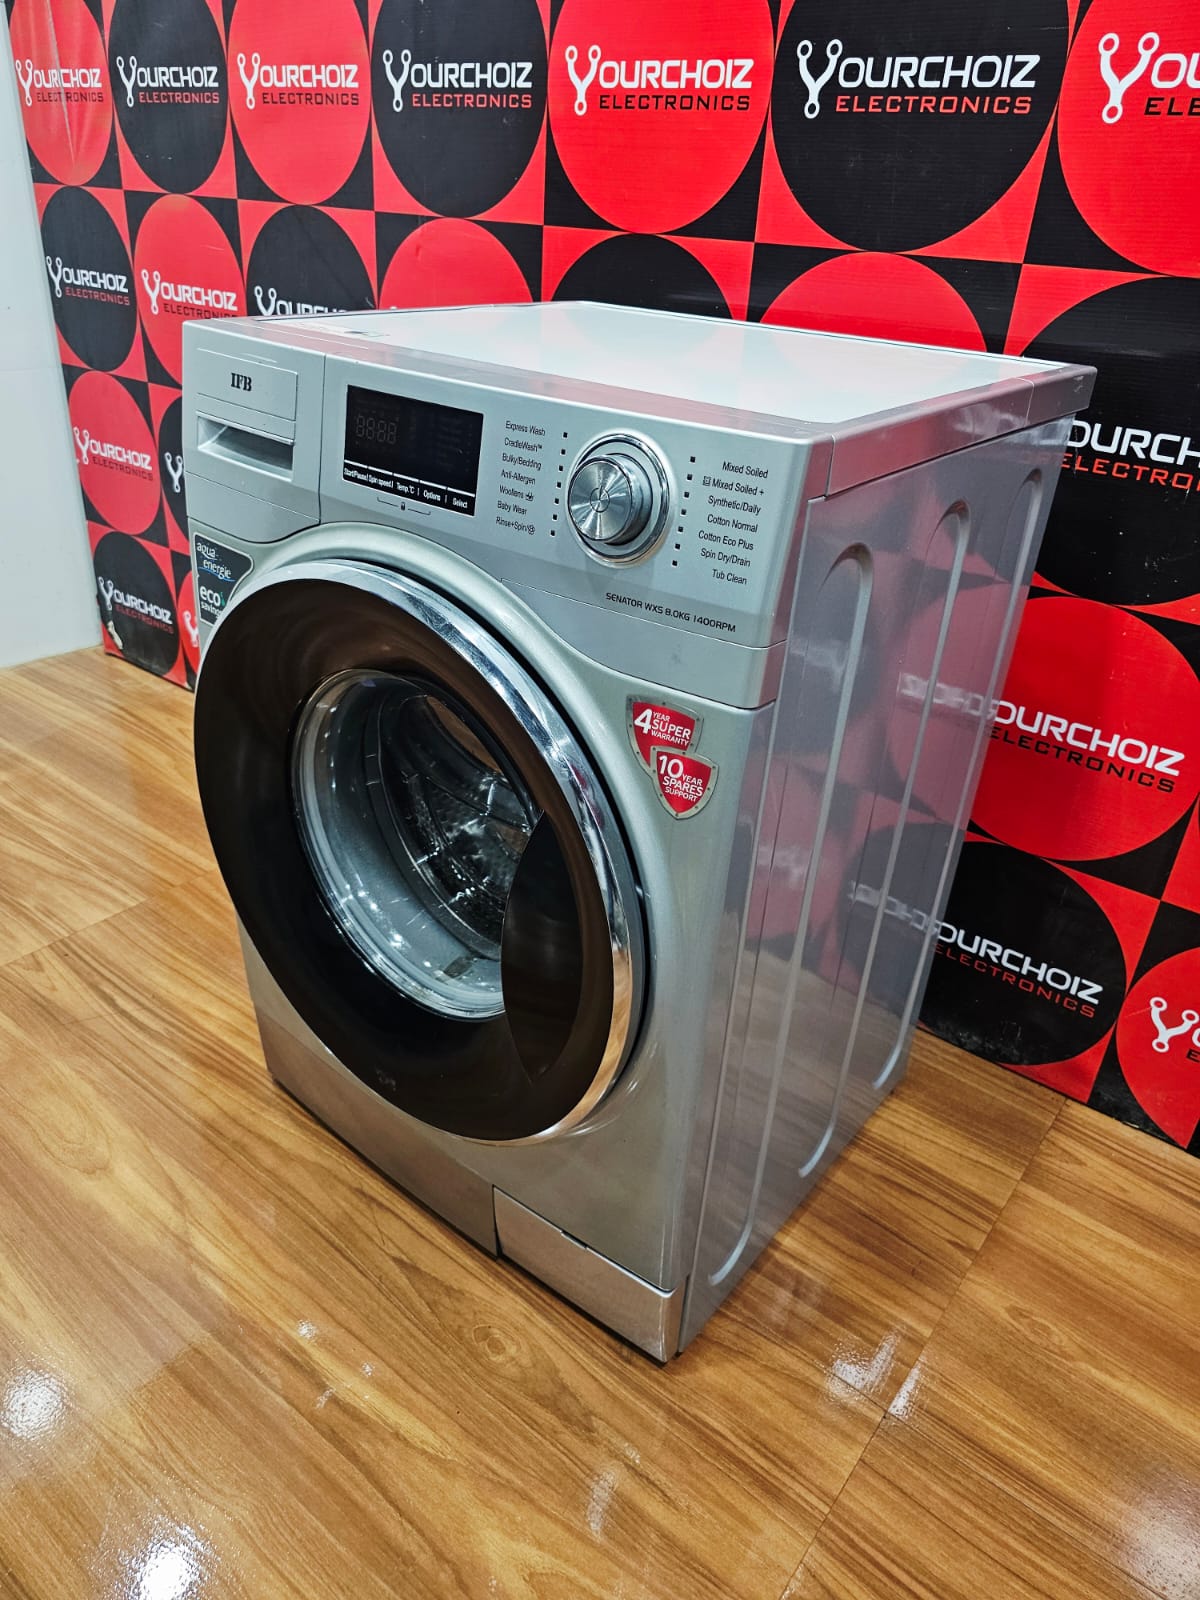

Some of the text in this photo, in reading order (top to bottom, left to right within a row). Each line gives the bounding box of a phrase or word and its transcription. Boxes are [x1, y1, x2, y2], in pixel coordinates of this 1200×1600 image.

[15, 59, 102, 107] YOURCHOIZ
[116, 55, 219, 108] YOURCHOIZ
[236, 52, 360, 110] YOURCHOIZ
[382, 49, 533, 112] YOURCHOIZ
[564, 44, 754, 115] YOURCHOIZ
[797, 38, 1041, 119] YOURCHOIZ
[36, 91, 104, 103] ELECTRONICS
[138, 91, 220, 105] ELECTRONICS
[260, 92, 360, 106] ELECTRONICS
[411, 94, 533, 109] ELECTRONICS
[599, 94, 751, 112] ELECTRONICS
[835, 95, 1032, 115] ELECTRONICS
[45, 255, 129, 298] YOURCHOIZ
[64, 286, 130, 306] ELECTRONICS
[141, 268, 238, 315] YOURCHOIZ
[230, 372, 253, 392] IFB
[505, 420, 546, 436] Express Wash
[73, 426, 153, 471] YOURCHOIZ
[502, 452, 541, 471] Bulky/Bedding
[722, 460, 769, 479] Mixed Soiled
[501, 468, 536, 485] Anti-Allergen
[1060, 452, 1200, 492] ELECTRO
[499, 484, 524, 499] Woollens
[712, 478, 734, 491] Mixed
[734, 482, 758, 496] Soiled
[423, 490, 441, 501] Options
[452, 497, 468, 509] Select
[497, 500, 528, 516] Baby Wear
[708, 495, 761, 516] Synthetic/Daily
[707, 513, 758, 533] Cotton Normal
[698, 529, 754, 551] Cotton Eco Plus
[196, 542, 217, 560] aqua
[700, 547, 751, 567] Spin Dry/Drain
[203, 559, 232, 580] energie
[712, 568, 747, 585] Tub Clean
[98, 576, 173, 625] YOURCHOIZ
[199, 586, 221, 607] eco
[605, 592, 736, 632] SENATOR WXS 8.0KG 1400RPM
[634, 708, 653, 735] 4
[653, 711, 671, 722] YEAR
[651, 719, 692, 740] SUPER
[651, 729, 690, 747] WARRANTY
[989, 726, 1176, 793] ELECTRONICS
[659, 755, 703, 786] 10 YEAR
[662, 775, 704, 797] SPARES
[664, 786, 698, 802] SUPPORT
